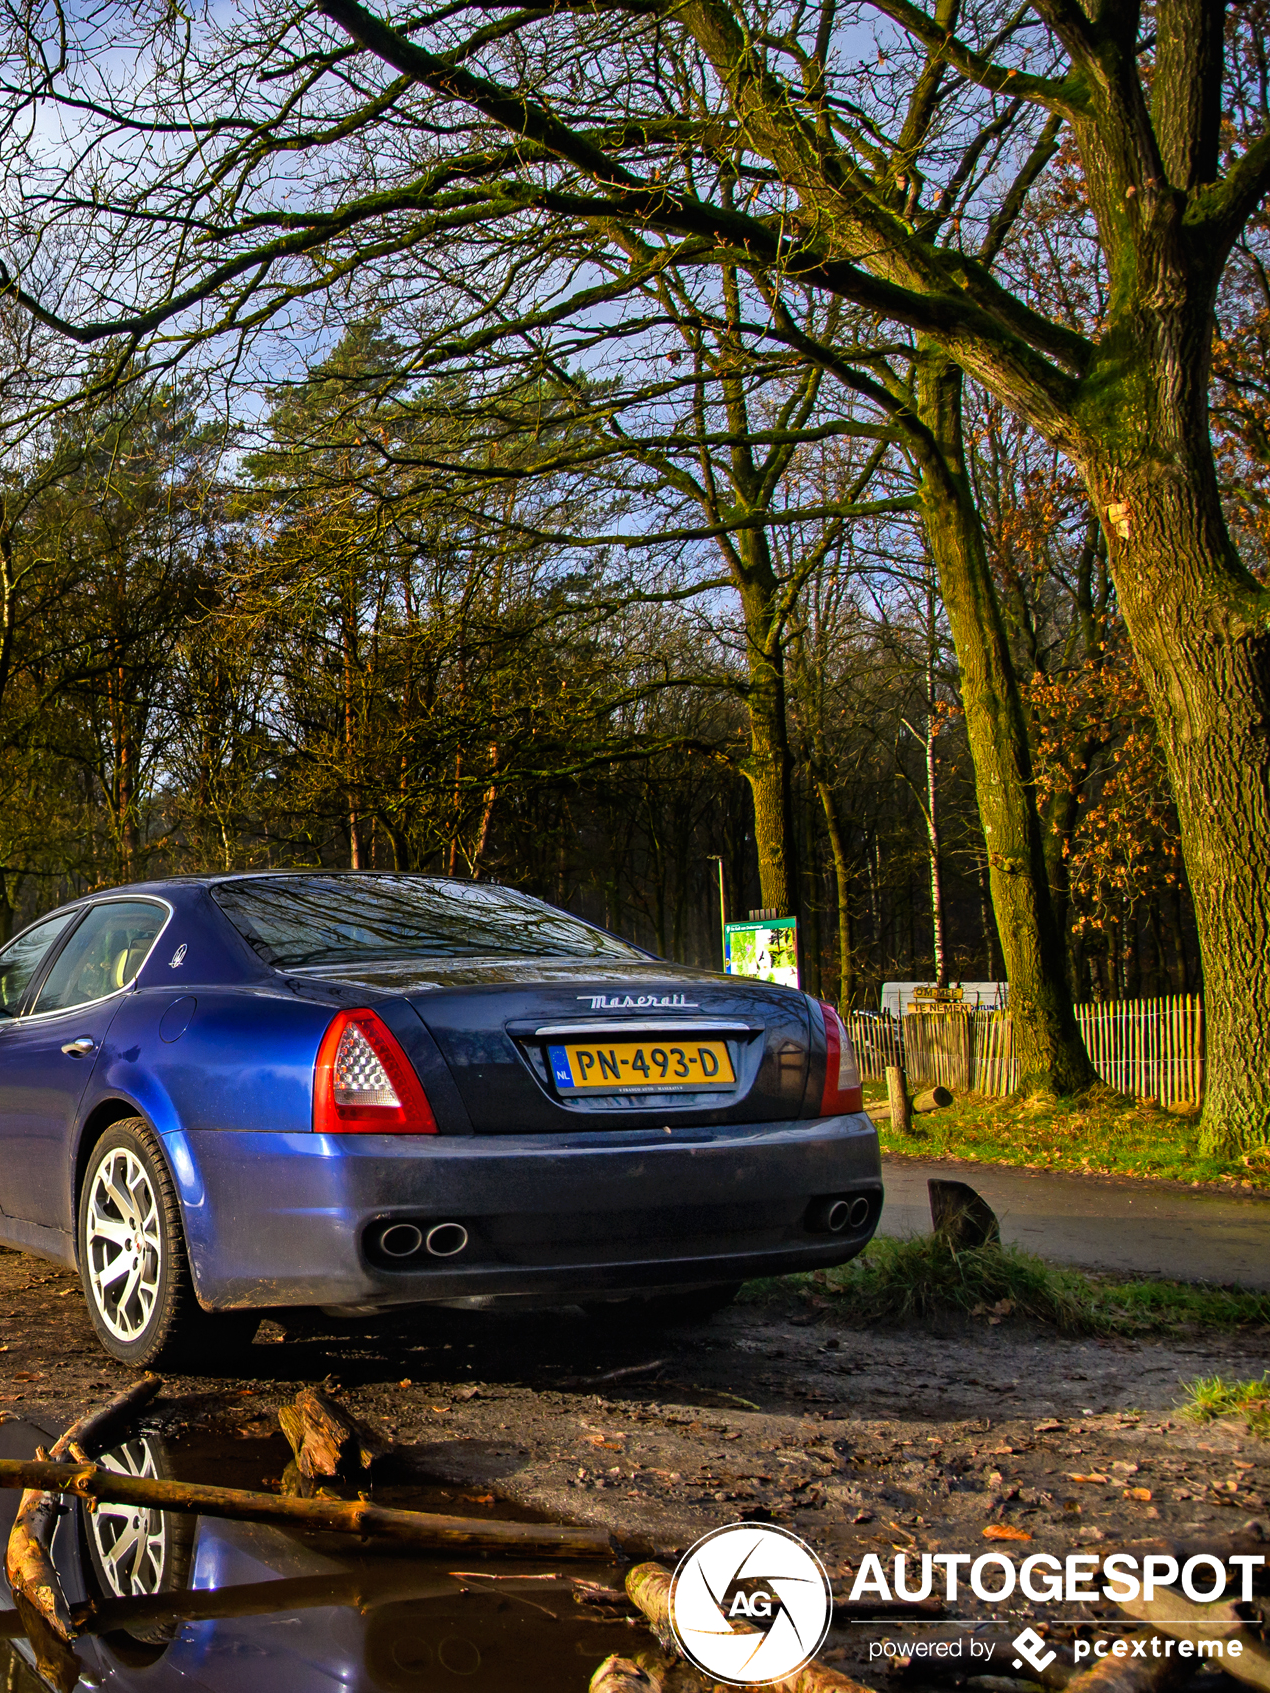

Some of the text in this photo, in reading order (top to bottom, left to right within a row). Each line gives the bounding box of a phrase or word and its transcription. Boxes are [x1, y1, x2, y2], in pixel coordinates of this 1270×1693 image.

[577, 994, 699, 1009] Maserati
[914, 1004, 968, 1013] TE NEMEN
[576, 1047, 719, 1080] PN-493-D
[556, 1070, 570, 1081] NL
